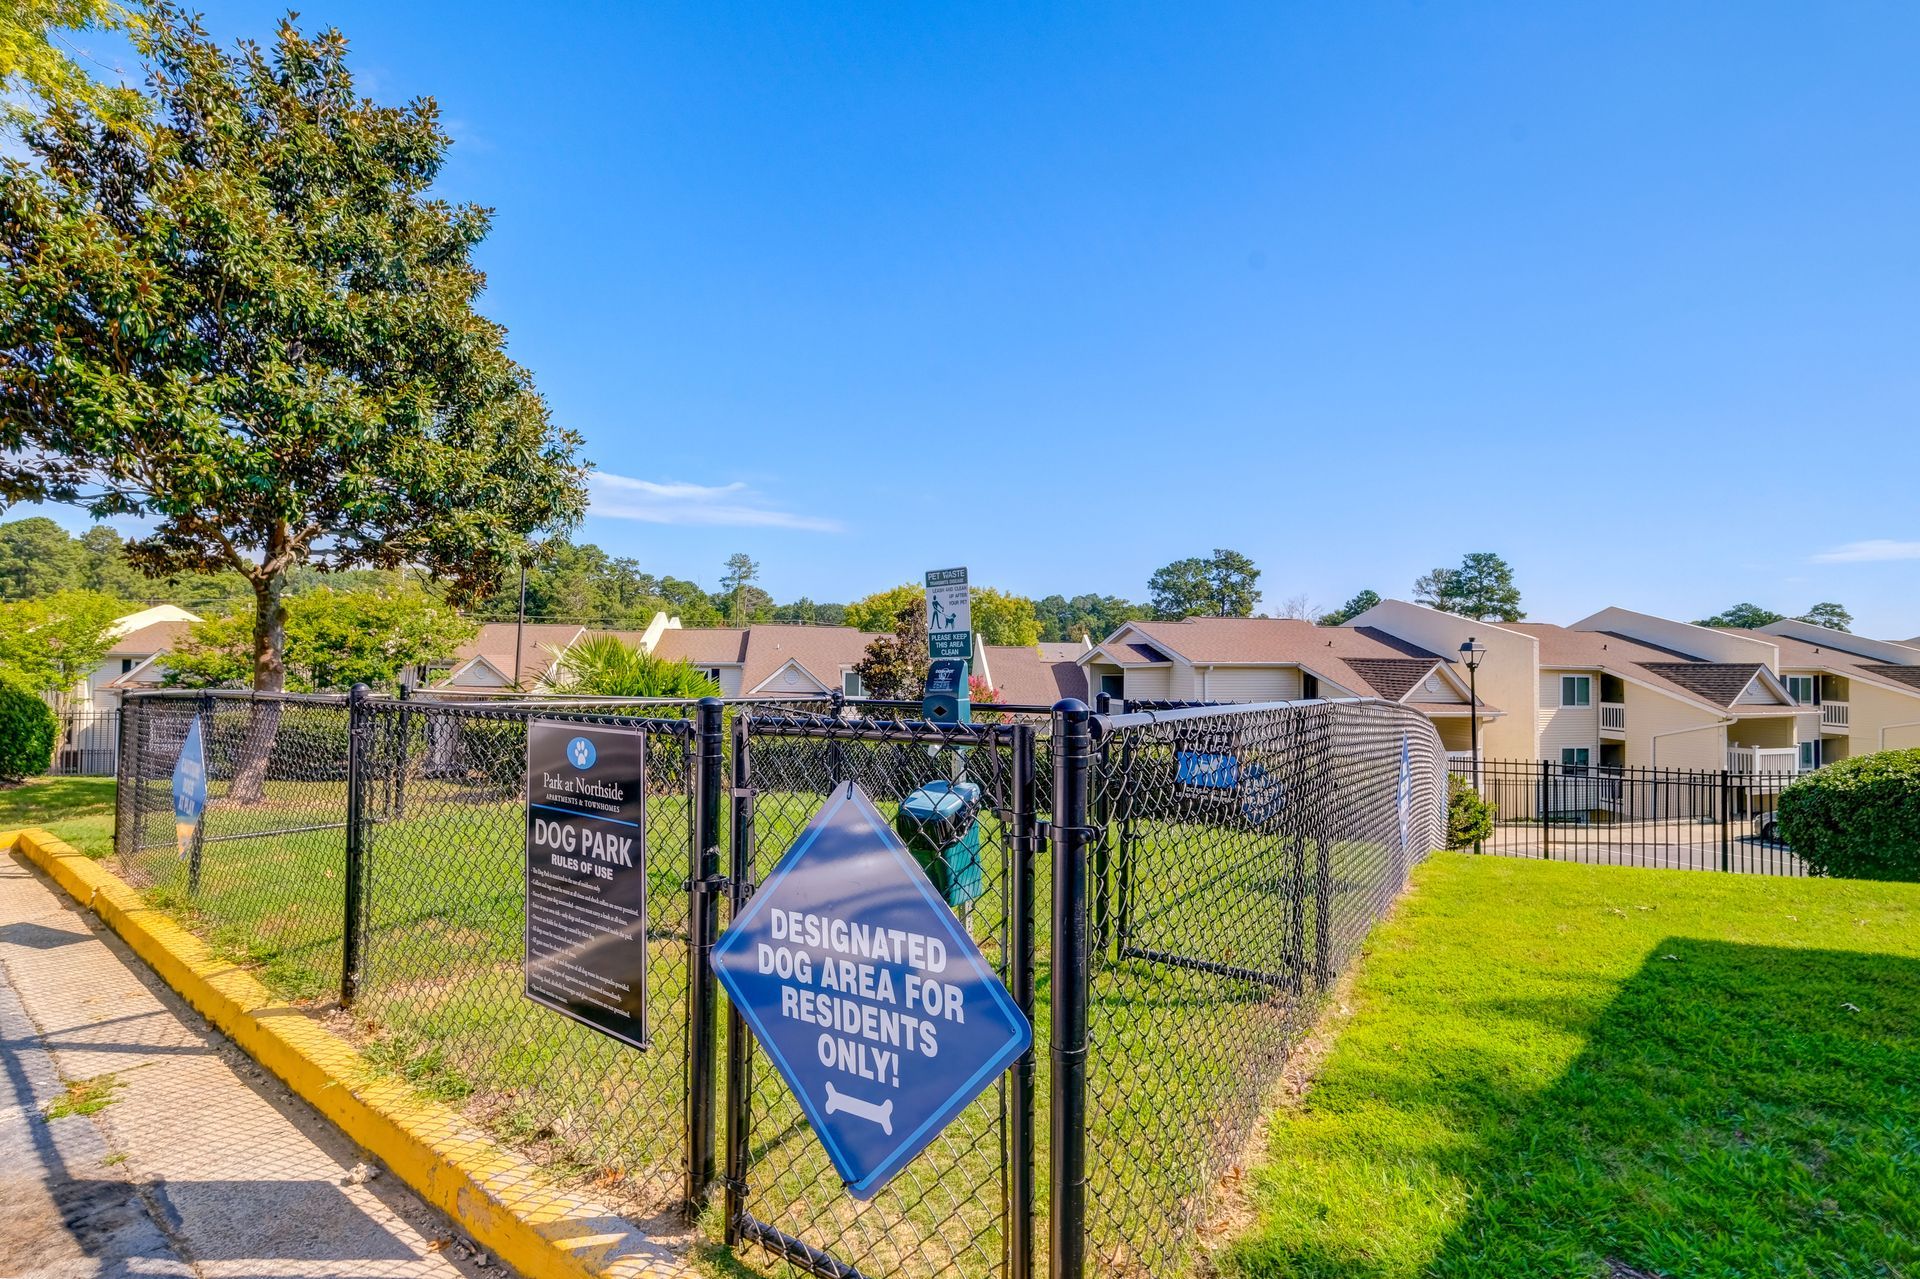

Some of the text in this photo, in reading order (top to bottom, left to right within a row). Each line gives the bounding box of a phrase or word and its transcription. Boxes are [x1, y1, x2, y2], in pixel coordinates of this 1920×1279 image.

[943, 570, 965, 579] WASTE
[544, 772, 624, 800] Park at Northside
[546, 794, 578, 805] APARTMENTS
[585, 800, 620, 813] TOWNHOMES
[535, 818, 633, 868] DOG PARK
[552, 854, 578, 871] RULES
[580, 861, 592, 874] OF
[594, 865, 613, 880] USE
[771, 908, 947, 974] DESIGNATED
[758, 943, 965, 1024] DOG AREA FOR
[782, 985, 938, 1058] RESIDENTS
[818, 1033, 899, 1088] ONLY!
